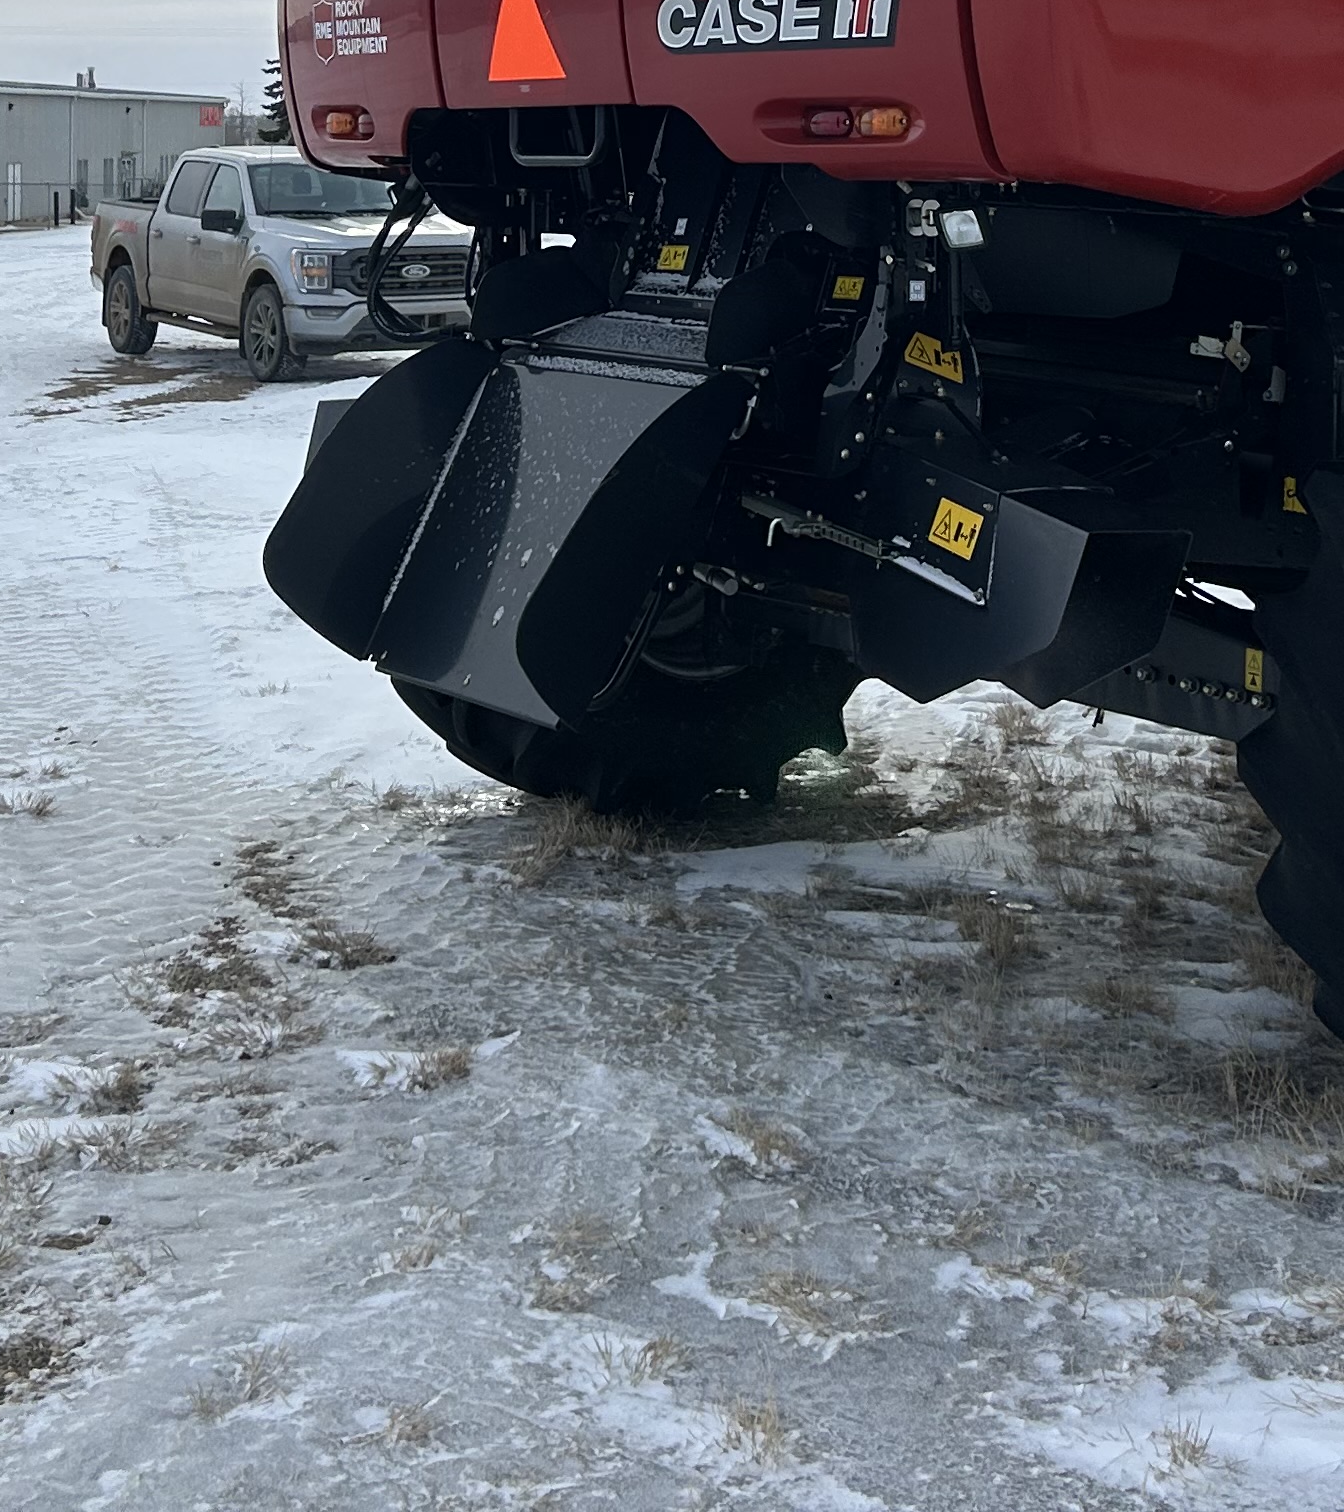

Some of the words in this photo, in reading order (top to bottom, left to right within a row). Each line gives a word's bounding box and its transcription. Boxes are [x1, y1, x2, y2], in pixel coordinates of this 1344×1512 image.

[336, 0, 364, 17] ROCKY
[315, 22, 332, 39] RME
[336, 17, 380, 36] MOUNTAIN
[337, 36, 387, 55] EQUIPMENT
